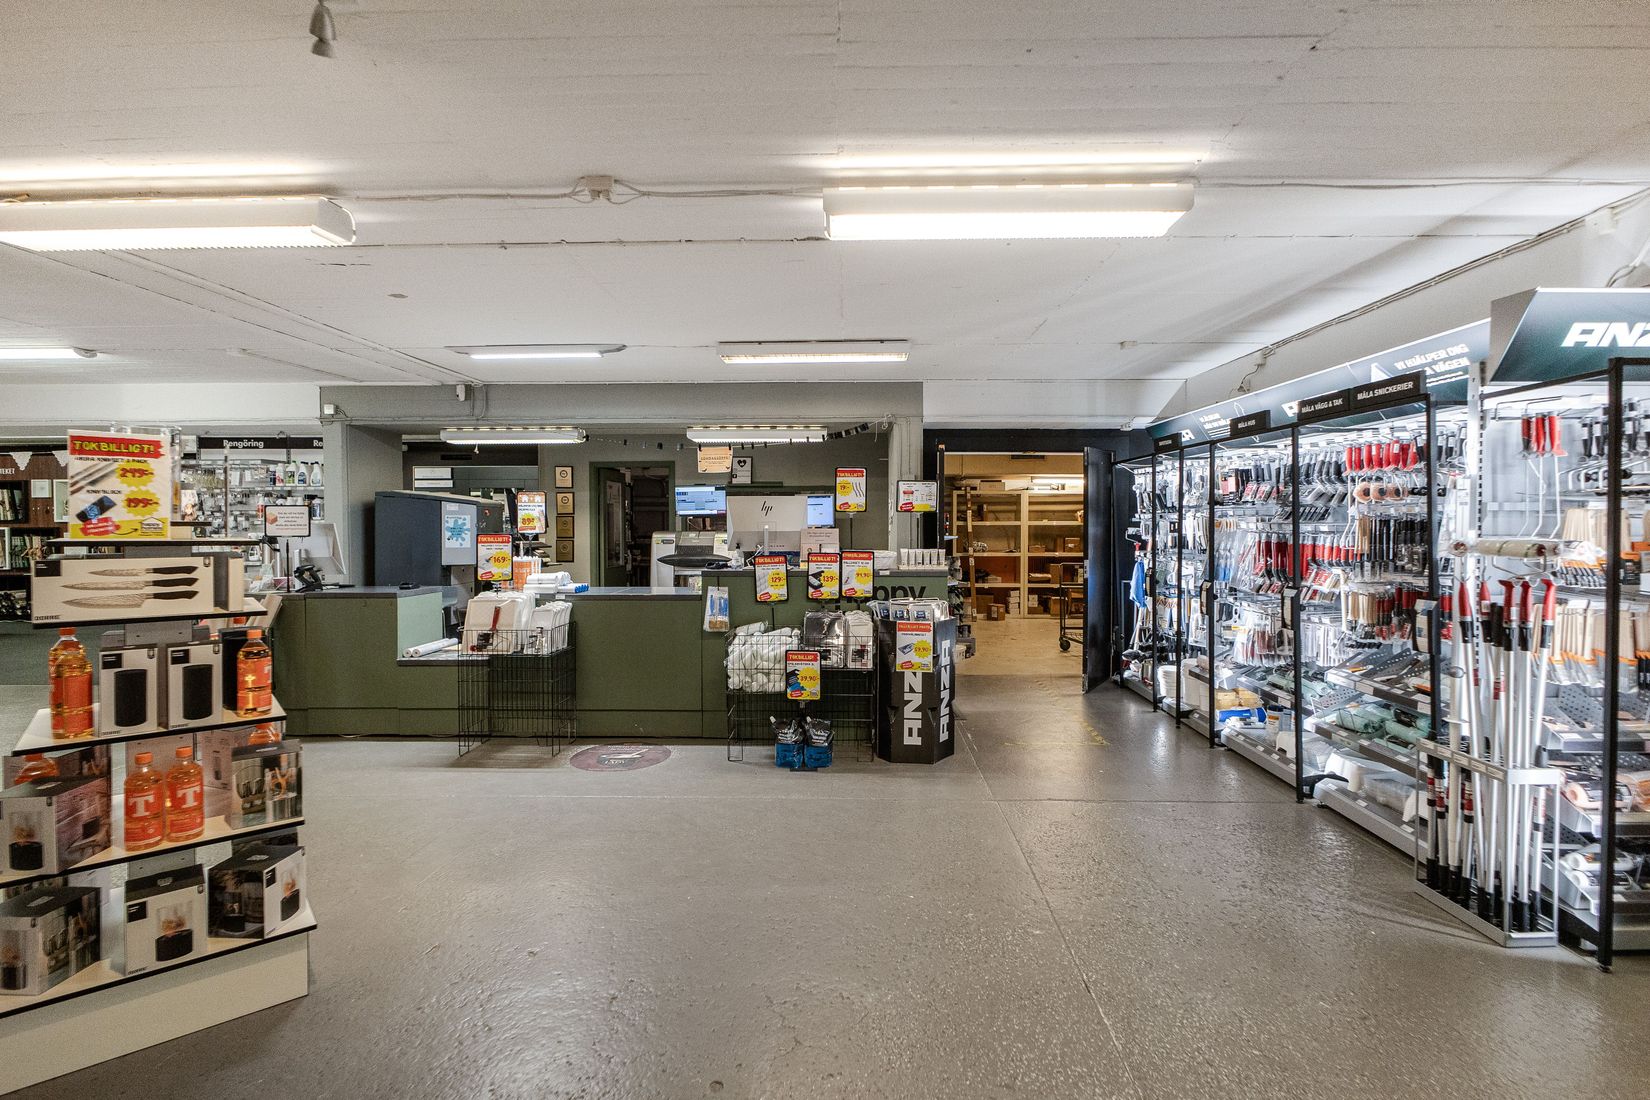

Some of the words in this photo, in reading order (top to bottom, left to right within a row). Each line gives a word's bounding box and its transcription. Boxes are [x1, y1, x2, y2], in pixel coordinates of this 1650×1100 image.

[1357, 391, 1374, 400] MÅLA
[1374, 381, 1414, 397] SNICKERIER
[1301, 404, 1314, 413] MÅLA
[1315, 401, 1329, 410] VÄGG
[223, 439, 264, 448] Rengöring
[940, 640, 950, 742] ANZA
[903, 671, 922, 746] ANZ
[128, 795, 153, 817] T
[177, 786, 201, 807] T
